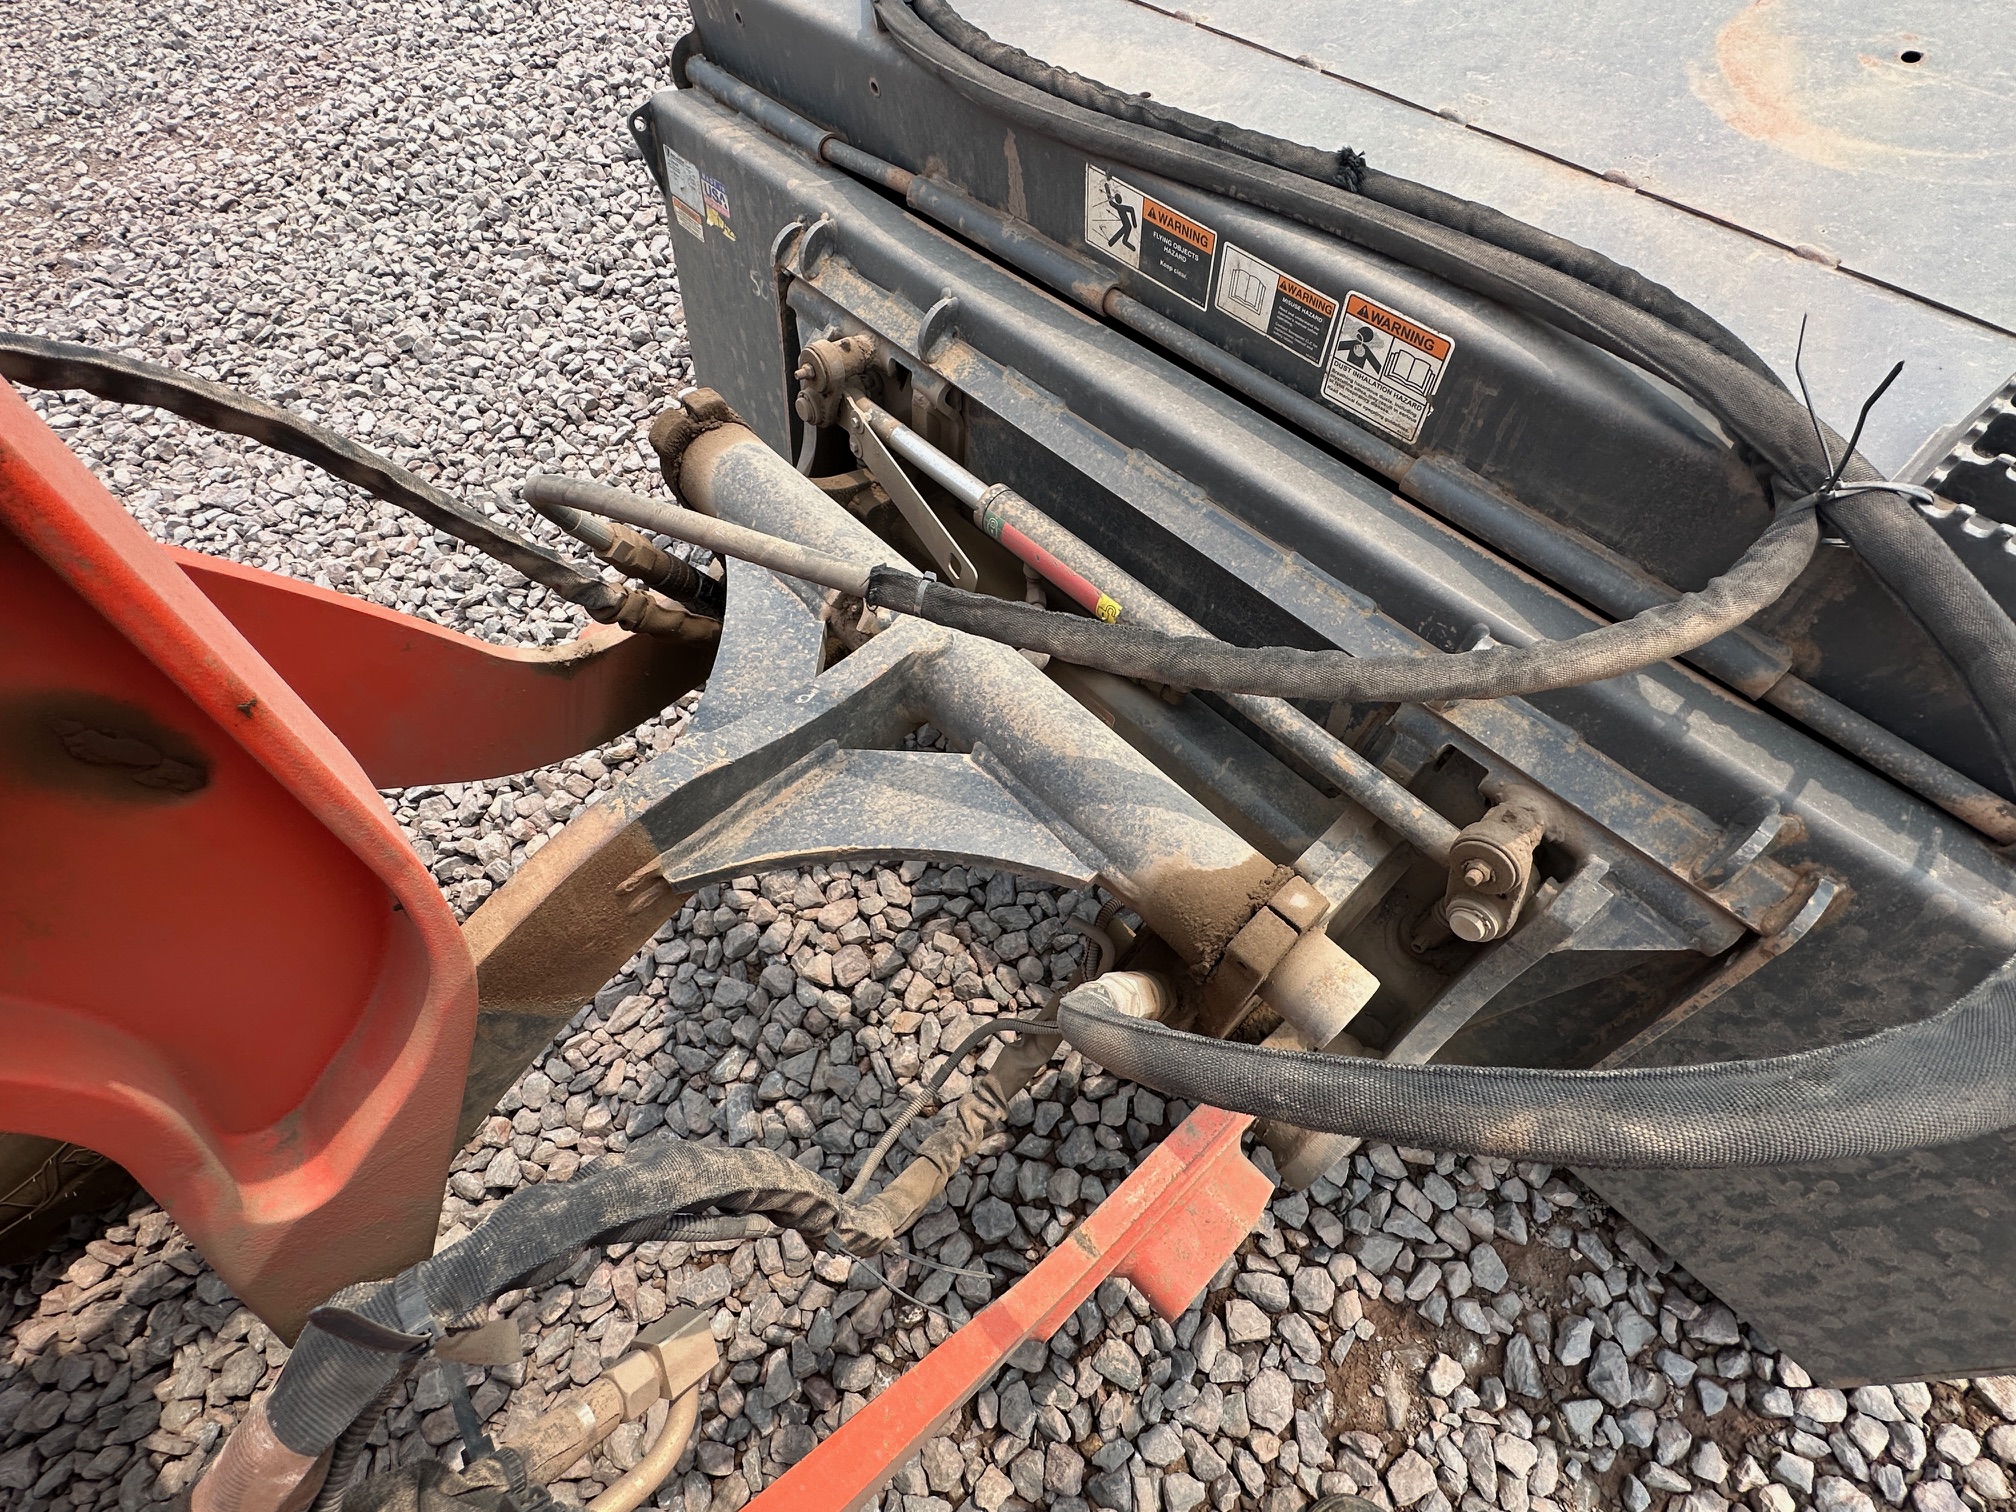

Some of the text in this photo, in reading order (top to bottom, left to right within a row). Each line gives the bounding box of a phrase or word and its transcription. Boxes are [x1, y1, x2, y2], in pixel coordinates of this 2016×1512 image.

[703, 182, 728, 210] USA
[1158, 211, 1208, 248] WARNING
[1153, 231, 1199, 262] FLYING OBJECTS
[1163, 246, 1187, 263] HAZARD
[1160, 259, 1173, 272] Keep
[1282, 297, 1323, 323] MISUSE HAZARD
[1287, 283, 1333, 315] WARNING
[1371, 310, 1435, 352] WARNING
[1327, 384, 1339, 393] Read
[1339, 390, 1355, 403] manual
[1362, 404, 1384, 420] operating
[1329, 373, 1354, 388] crystalline
[1398, 409, 1417, 424] serious
[1331, 367, 1354, 383] Breathing
[1354, 379, 1378, 397] hazardous
[1394, 401, 1417, 419] including
[1333, 360, 1423, 412] DUST INHALATION HAZARD
[1345, 385, 1370, 404] respiratory
